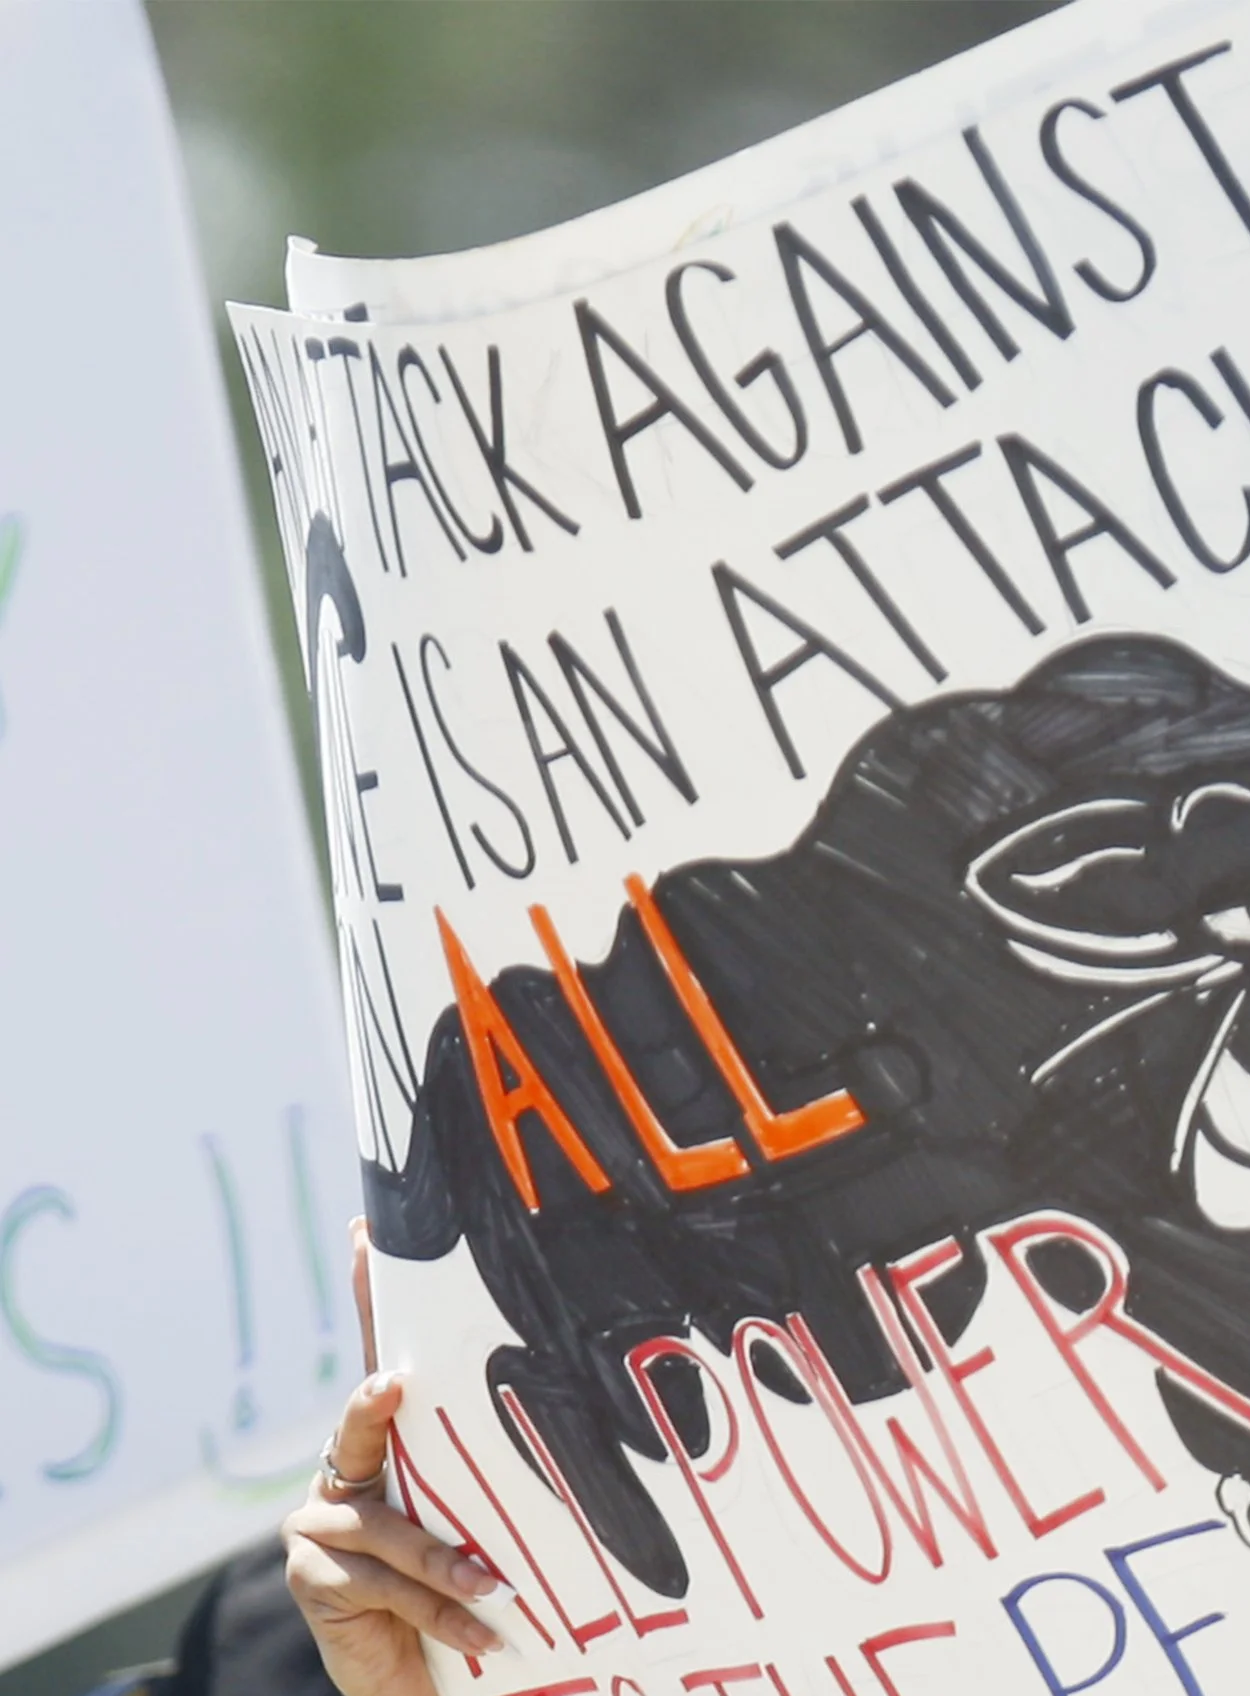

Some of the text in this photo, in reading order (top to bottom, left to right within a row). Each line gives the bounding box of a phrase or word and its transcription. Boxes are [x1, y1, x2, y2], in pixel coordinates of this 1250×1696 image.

[391, 633, 536, 890] IS
[498, 606, 700, 865] AN
[433, 872, 868, 1216] ALL
[387, 1388, 689, 1679] ALL
